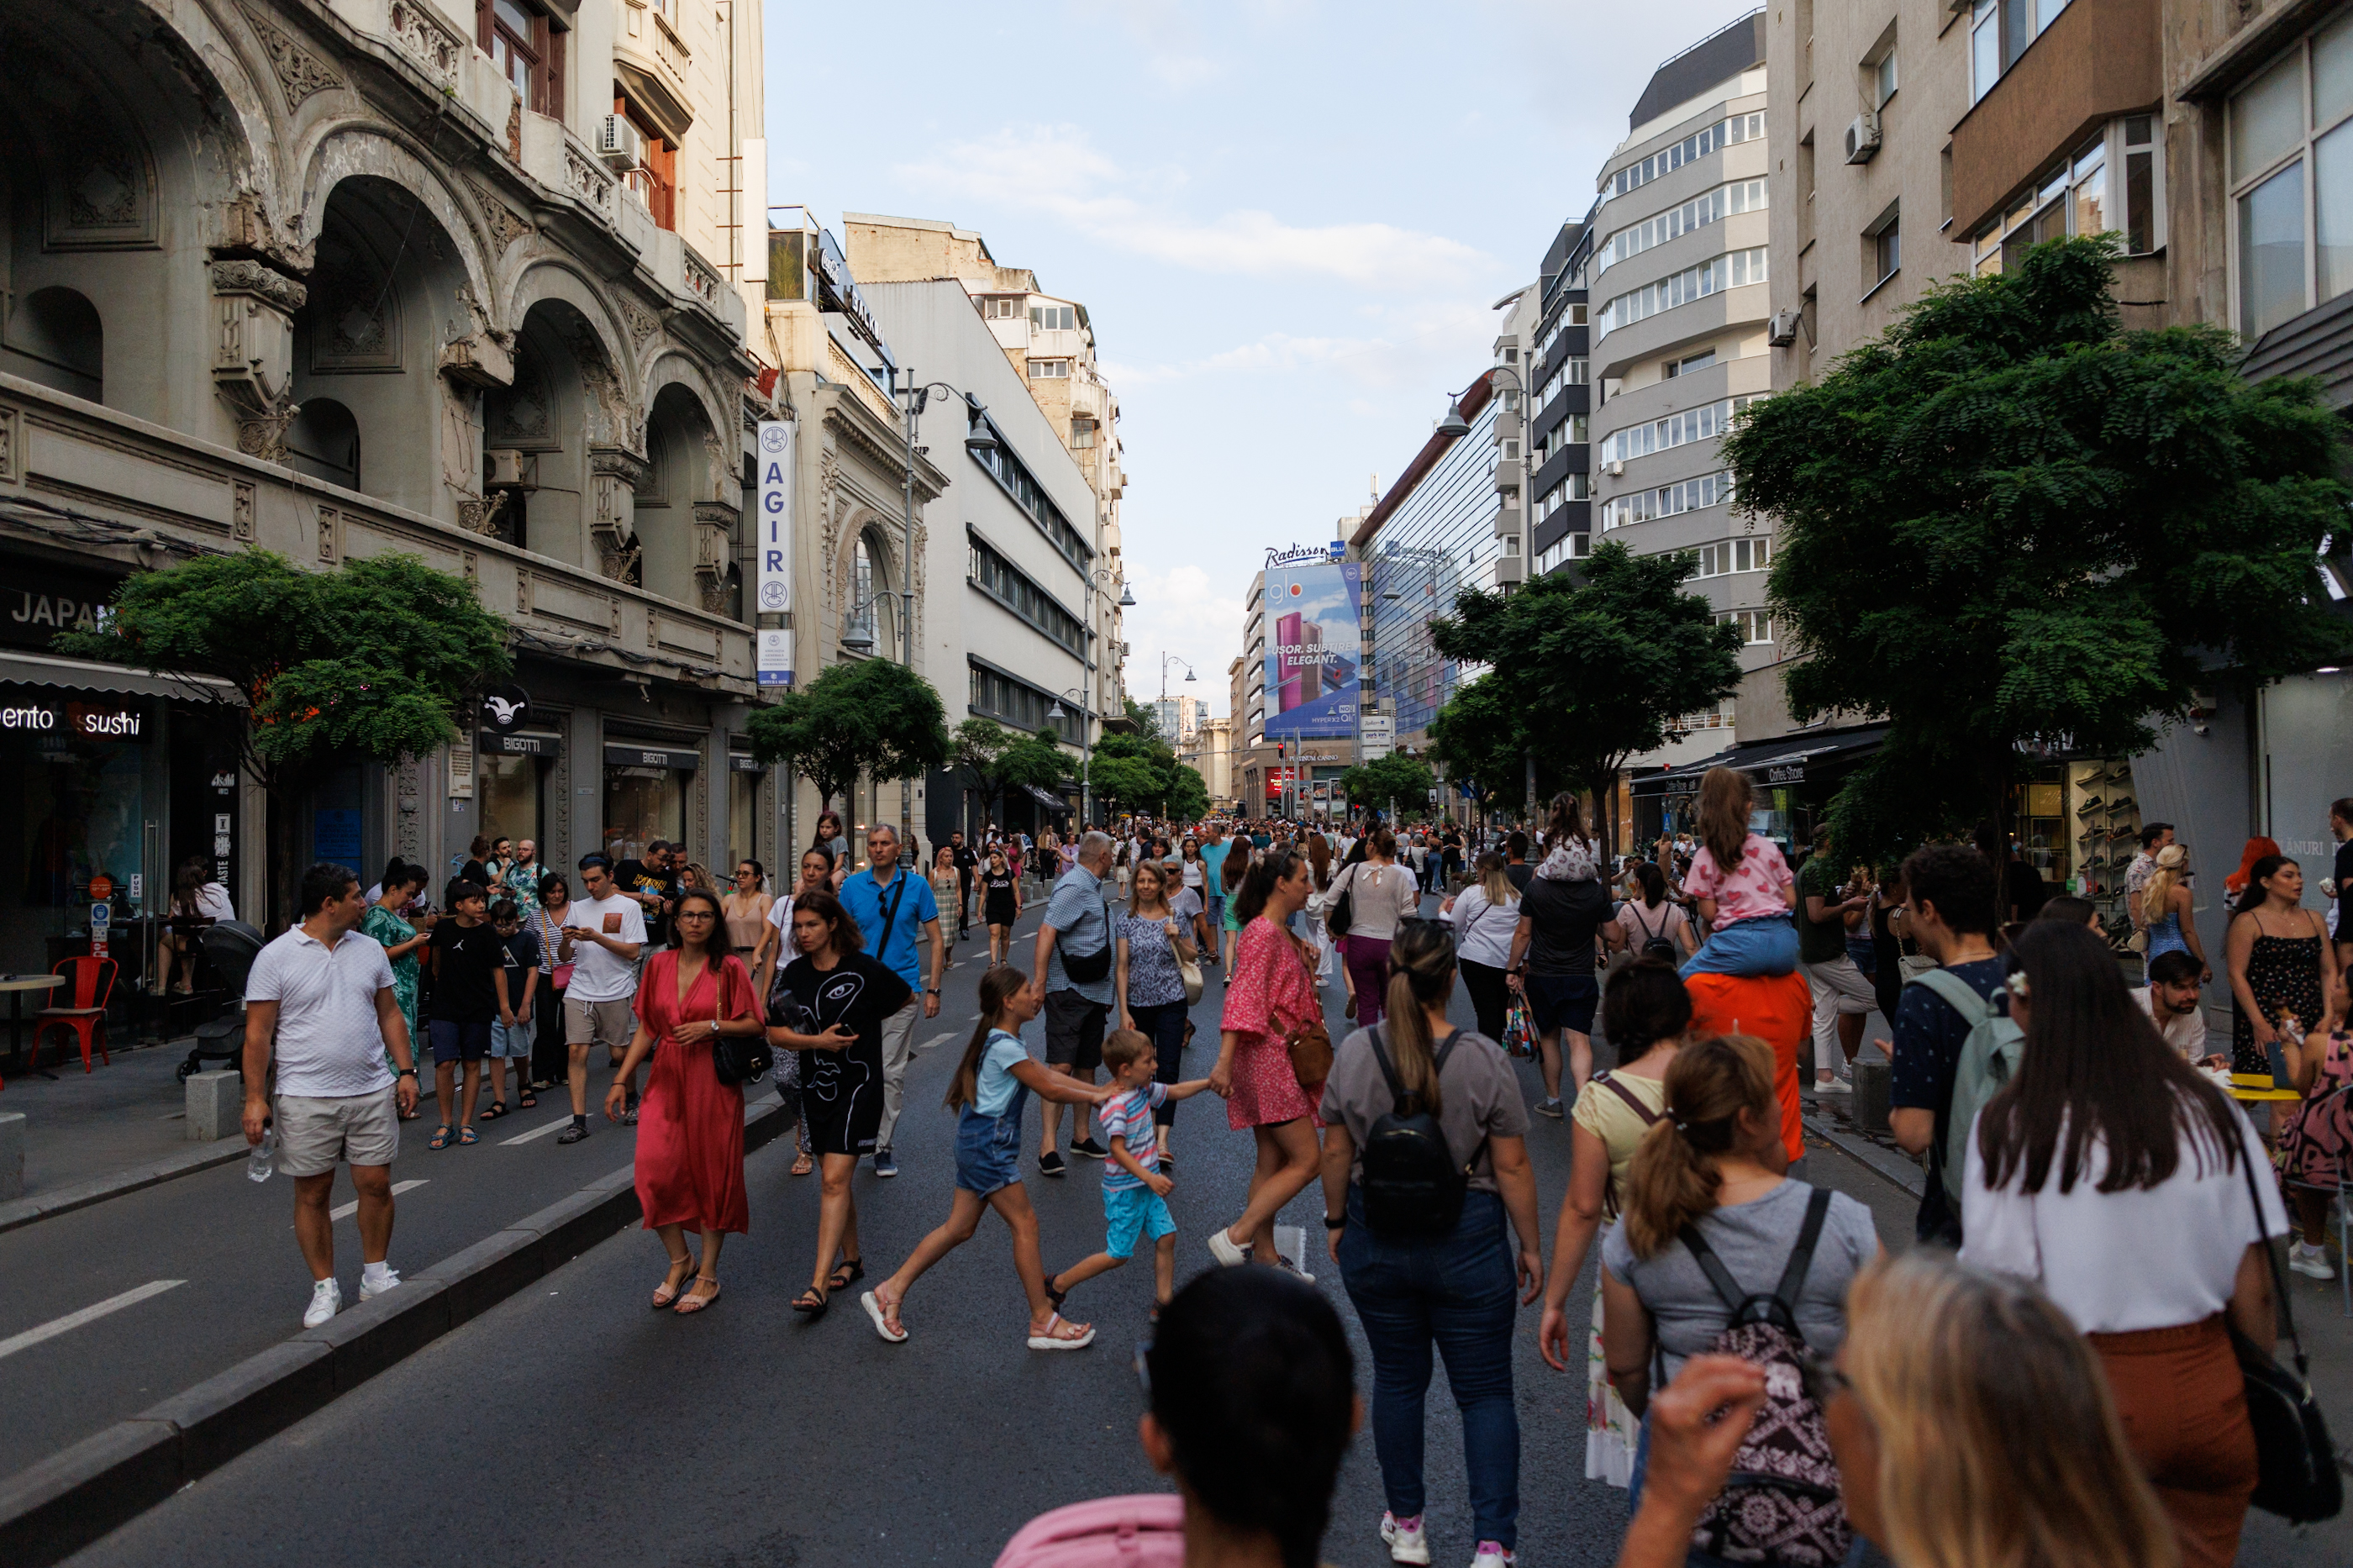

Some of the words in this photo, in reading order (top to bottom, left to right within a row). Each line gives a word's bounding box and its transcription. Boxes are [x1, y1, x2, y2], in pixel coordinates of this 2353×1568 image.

[851, 289, 884, 347] BALKON
[765, 462, 784, 572] AGIR
[1265, 542, 1329, 570] Radisson
[1269, 573, 1303, 605] glo
[1287, 655, 1338, 666] ELEGANT.
[0, 706, 54, 729] ento
[85, 711, 140, 735] sushi
[503, 737, 540, 752] BIGOTTI
[642, 752, 668, 765] BIGOTTI
[211, 773, 234, 787] Asahi
[1769, 767, 1787, 782] Coffee
[1787, 766, 1803, 780] Store
[2277, 837, 2324, 855] LĂNURI
